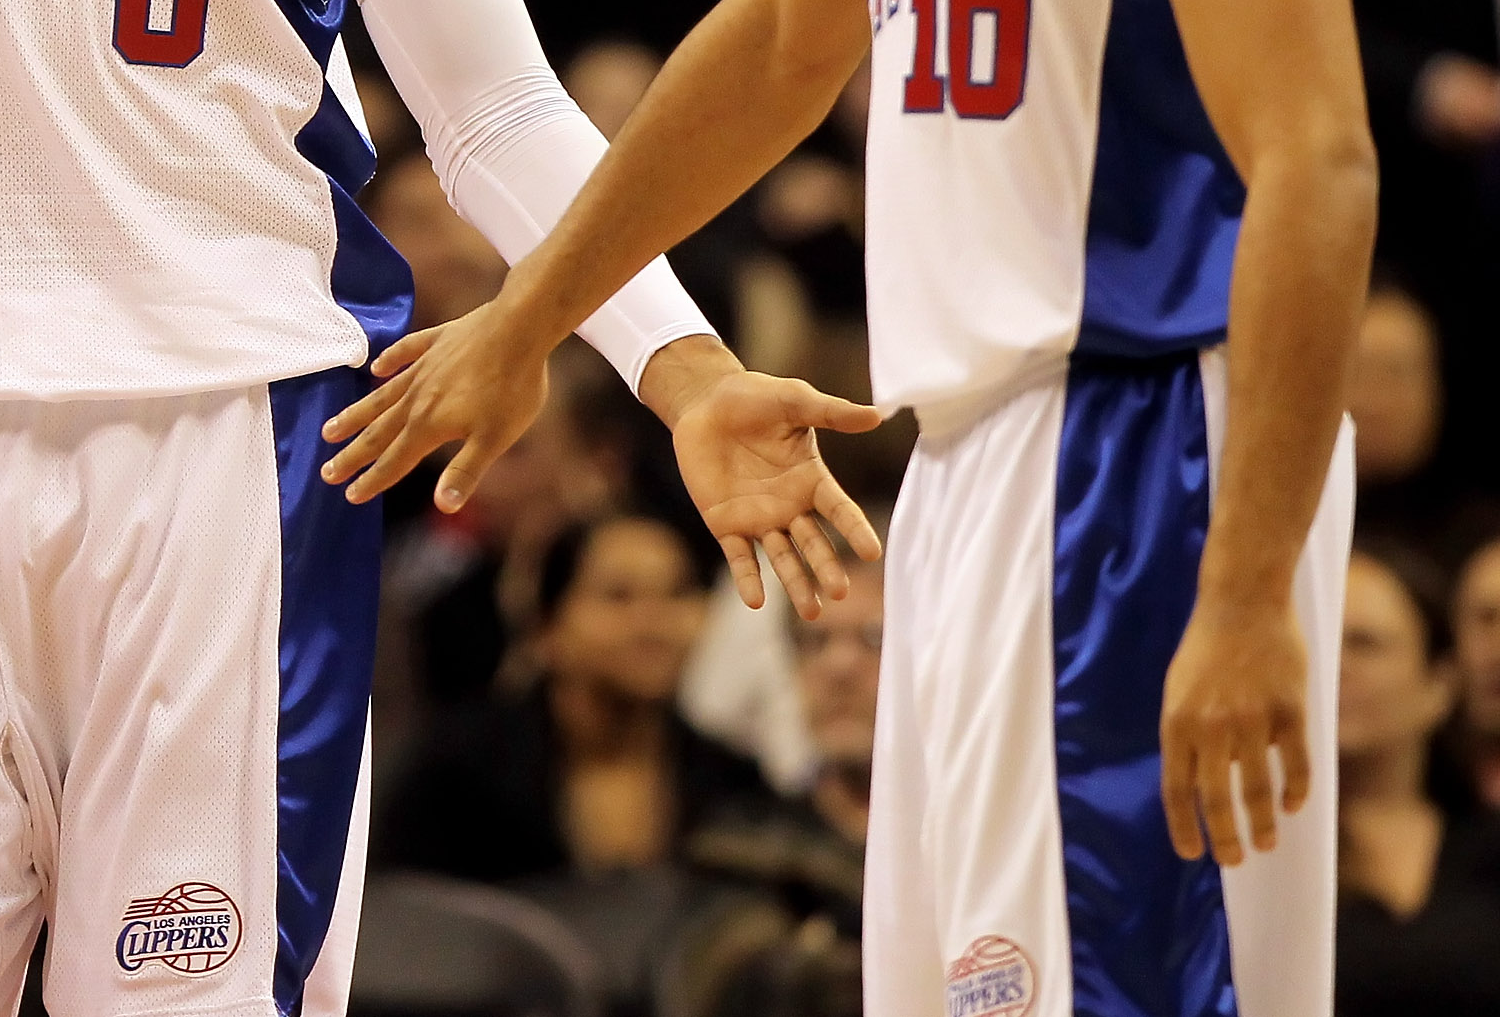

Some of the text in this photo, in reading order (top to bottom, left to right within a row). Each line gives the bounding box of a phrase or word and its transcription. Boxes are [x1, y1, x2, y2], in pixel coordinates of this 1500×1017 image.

[153, 914, 231, 930] LOS ANGELES
[115, 920, 229, 971] CLIPPERS
